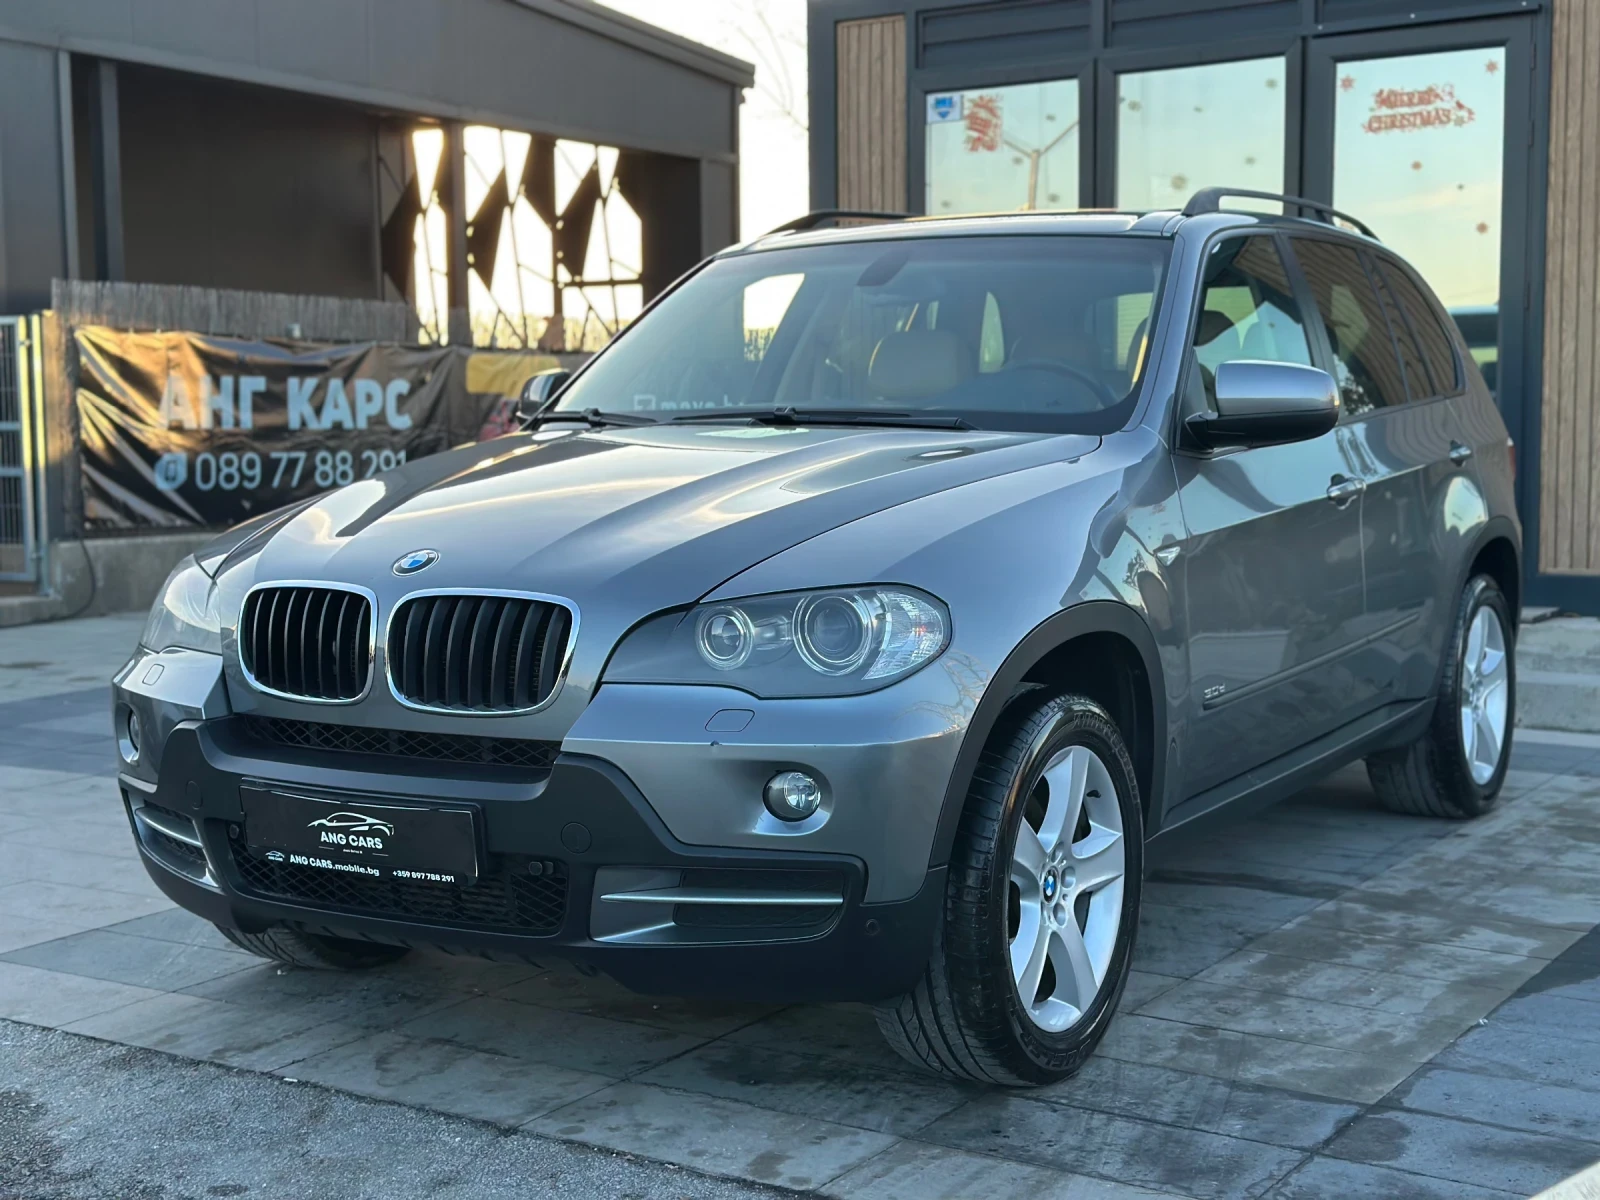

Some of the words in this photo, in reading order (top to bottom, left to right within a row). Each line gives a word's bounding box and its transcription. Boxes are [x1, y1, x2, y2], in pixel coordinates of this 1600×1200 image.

[1365, 109, 1452, 133] CHRISTMAS
[161, 375, 267, 430] АНГ
[287, 377, 413, 431] КАРС
[195, 451, 262, 491] 089
[270, 451, 307, 489] 77
[314, 450, 354, 488] 88
[320, 831, 347, 845] ANG
[349, 835, 383, 849] CARS
[290, 854, 308, 865] ANG
[309, 858, 380, 876] CARS.mobile.bg
[393, 870, 410, 878] +359
[441, 874, 454, 882] 291
